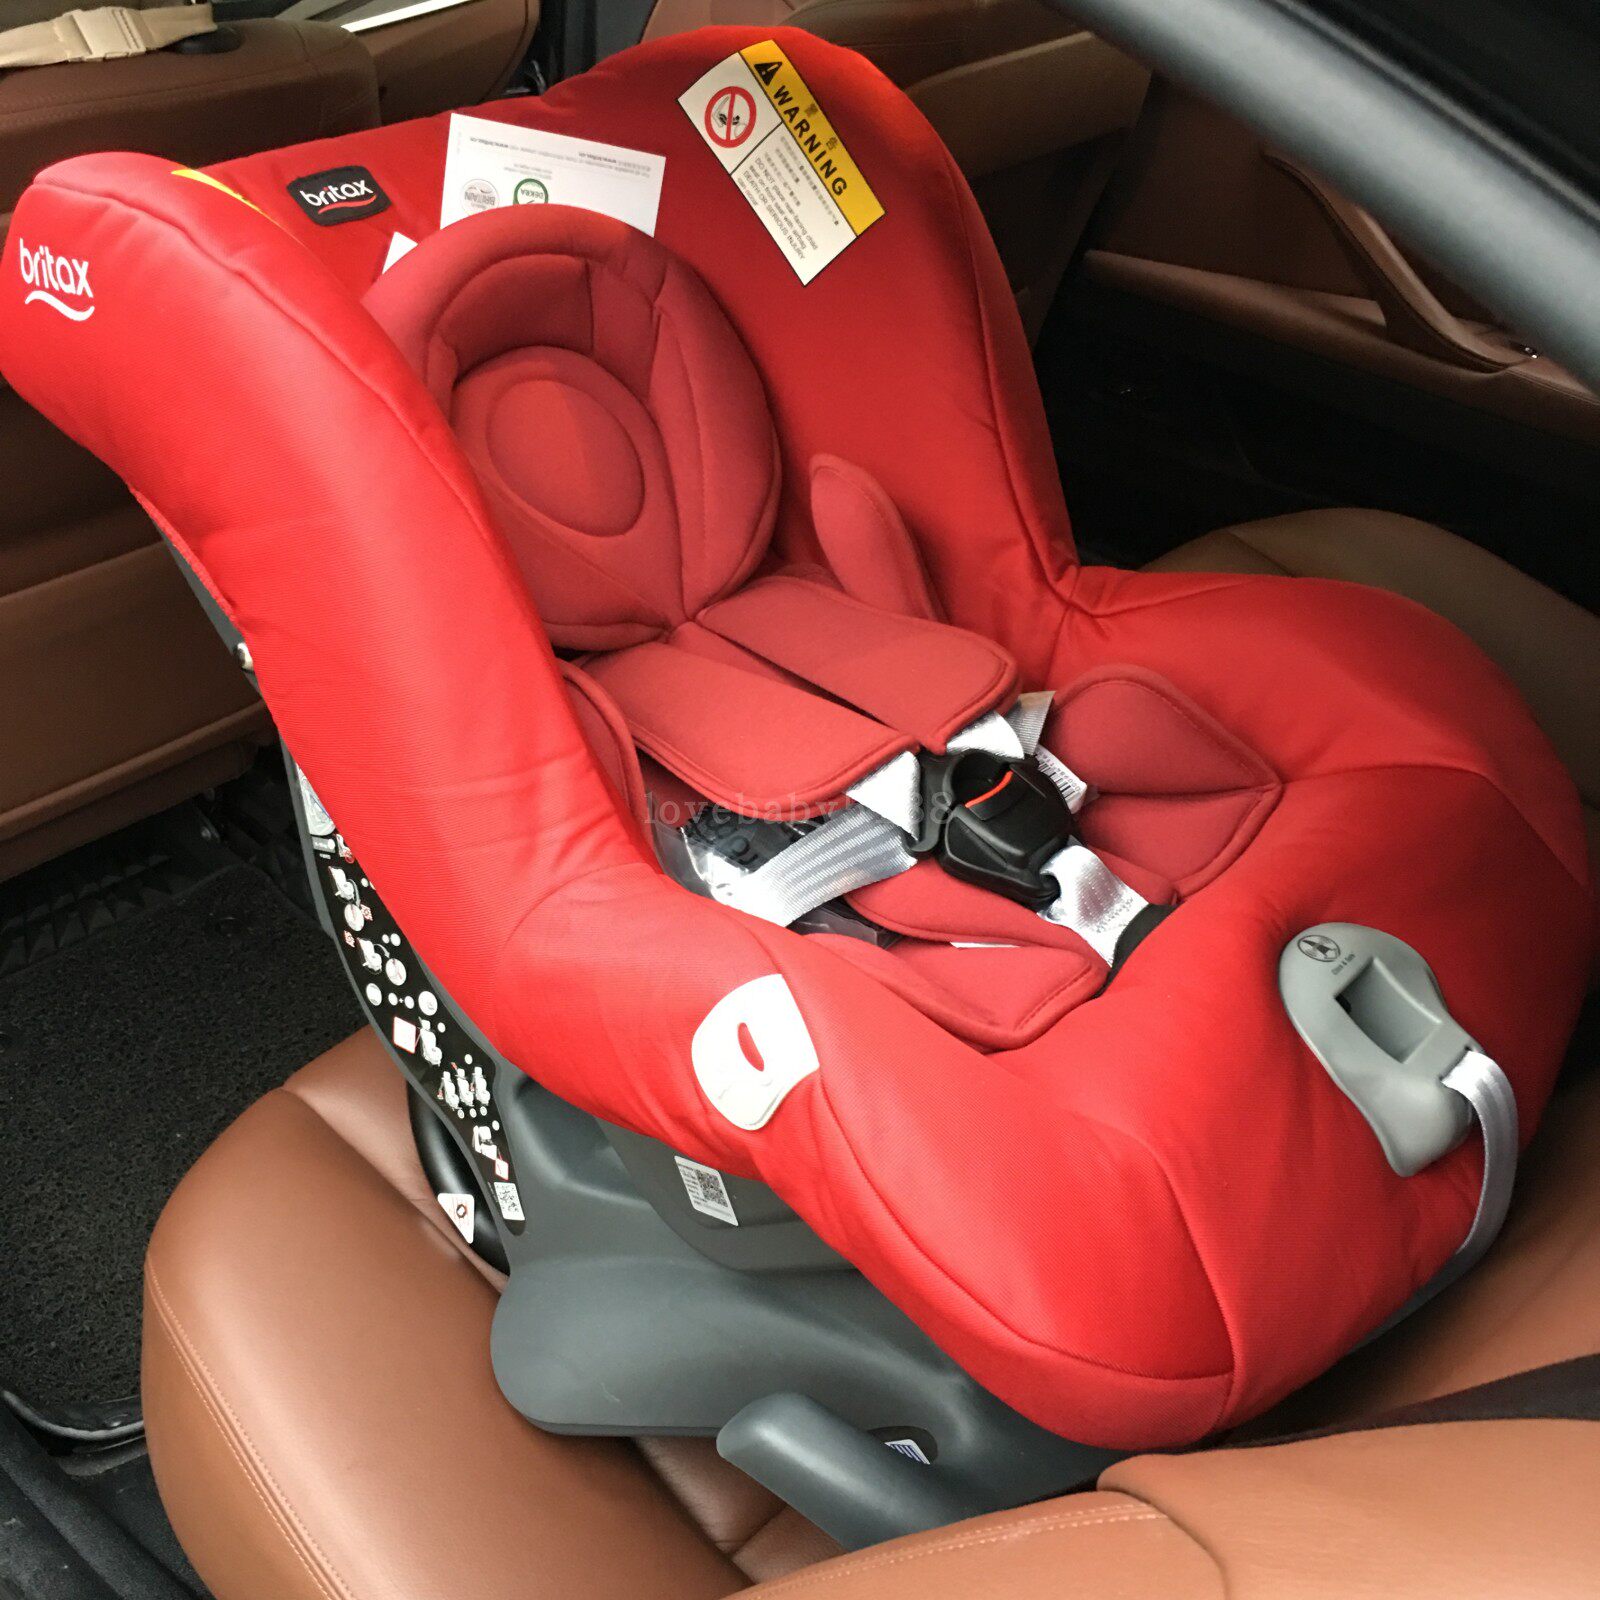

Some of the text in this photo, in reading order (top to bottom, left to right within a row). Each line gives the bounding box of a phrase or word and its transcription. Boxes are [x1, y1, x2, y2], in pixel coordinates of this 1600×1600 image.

[774, 85, 848, 196] WARNING
[300, 179, 374, 208] britax
[464, 191, 496, 206] BRITAIN
[20, 238, 94, 299] britax
